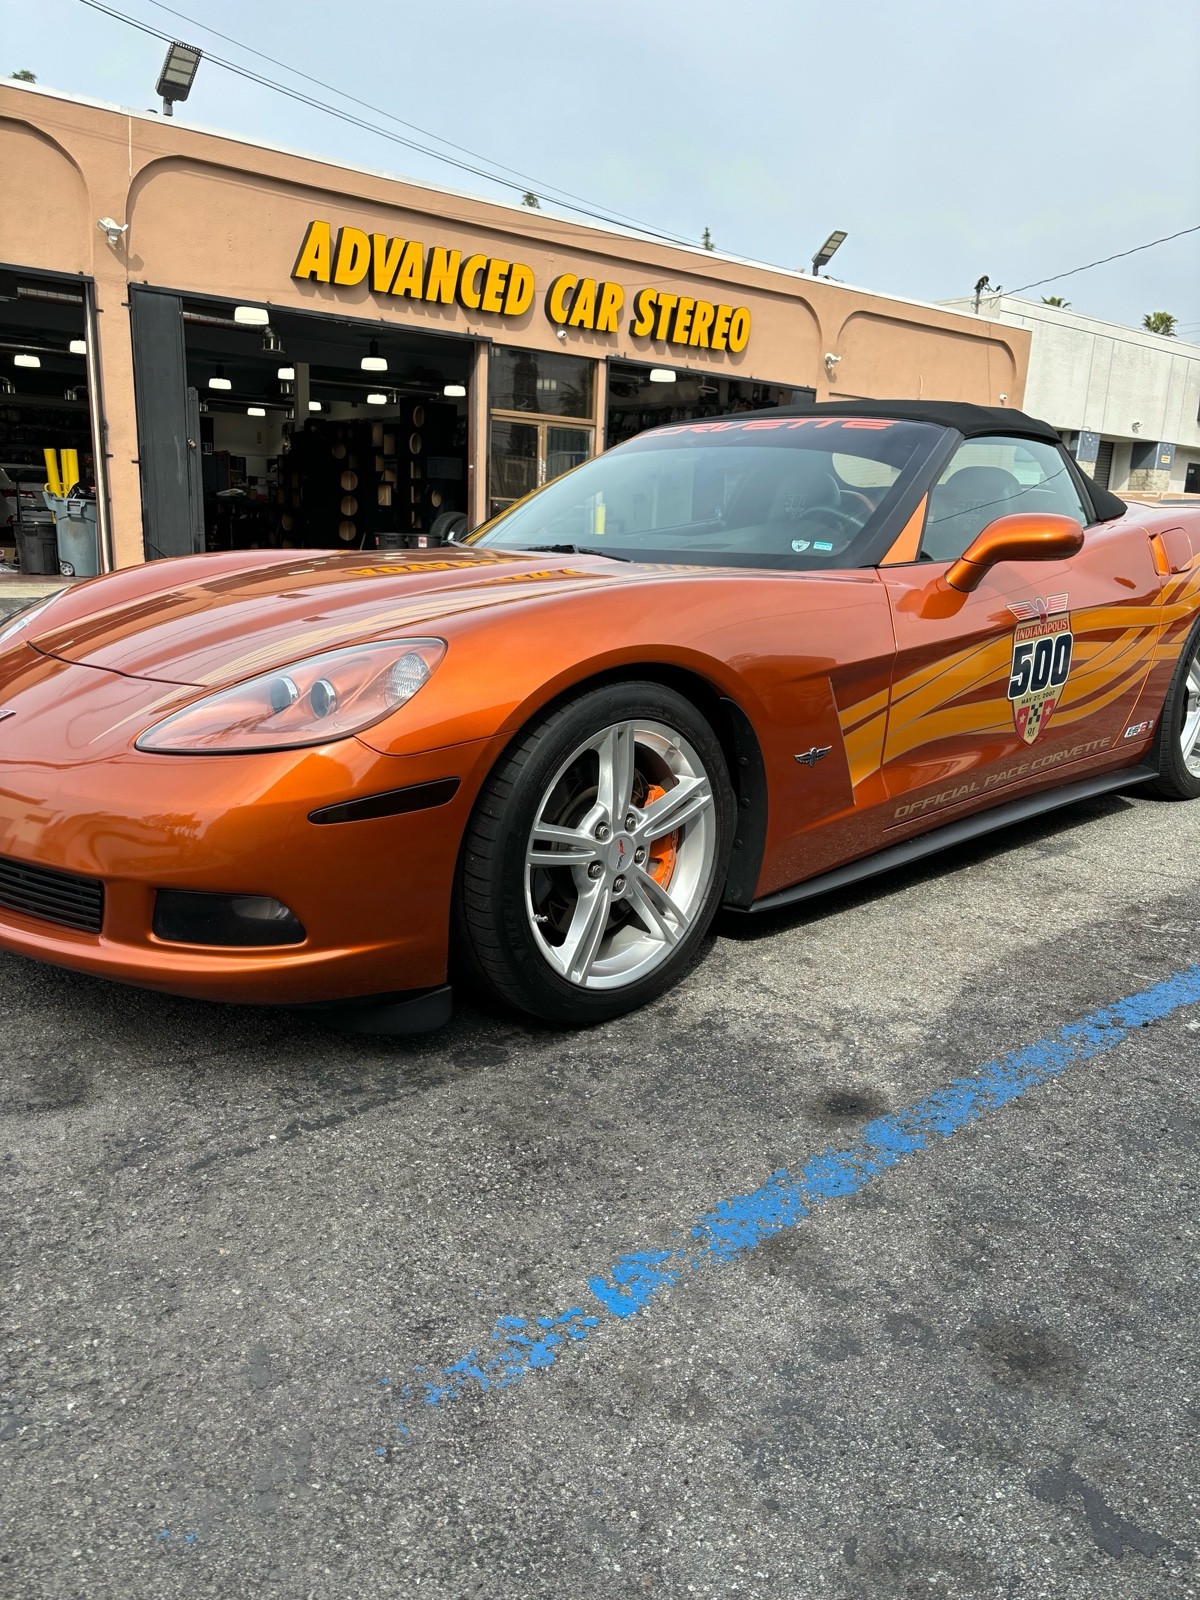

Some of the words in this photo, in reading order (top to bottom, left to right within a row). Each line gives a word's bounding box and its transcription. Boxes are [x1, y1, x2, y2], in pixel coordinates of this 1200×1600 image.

[292, 220, 535, 316] ADVANCED
[545, 273, 625, 333] CAR
[630, 288, 751, 353] STEREO
[1016, 619, 1068, 640] INDIANAPOLIS
[1008, 632, 1073, 700] 500
[1042, 690, 1055, 699] 2007
[894, 782, 980, 818] OFFICIAL
[984, 762, 1030, 787] PACE
[1031, 737, 1111, 770] CORVETTE
